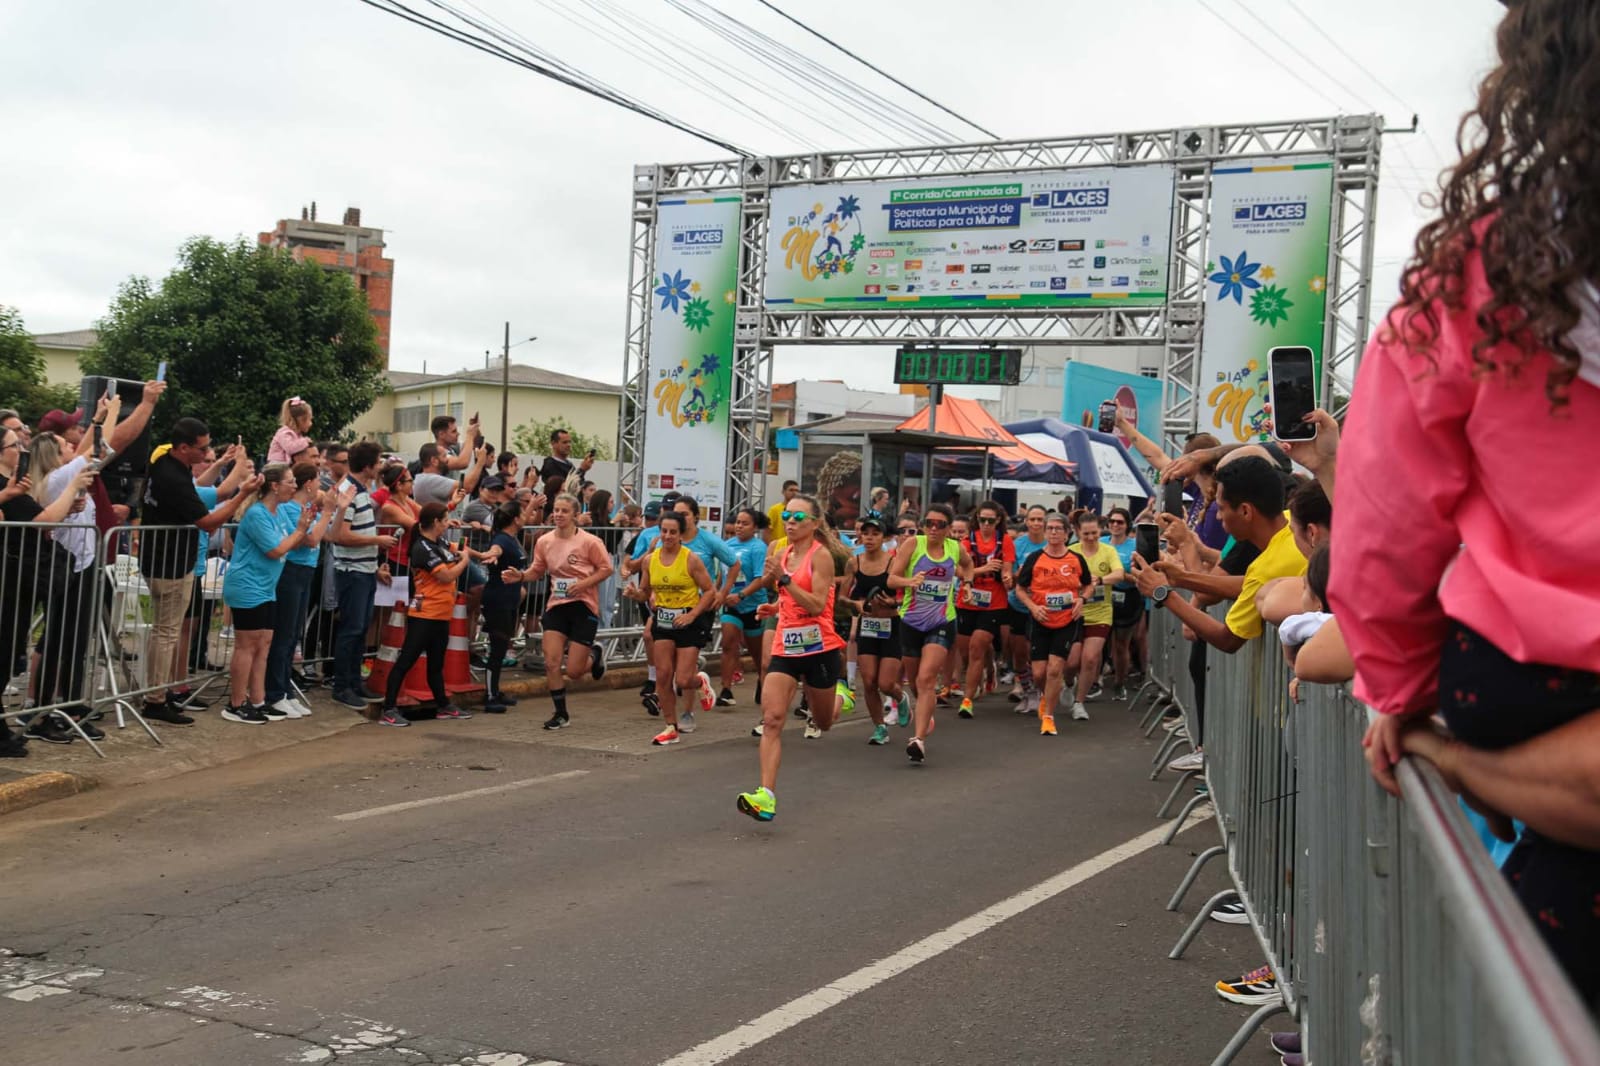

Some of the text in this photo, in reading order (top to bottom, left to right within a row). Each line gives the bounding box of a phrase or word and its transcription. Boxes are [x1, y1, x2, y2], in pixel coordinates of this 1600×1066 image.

[903, 186, 1001, 200] Corrida/Caminhada
[1004, 185, 1019, 195] da
[1053, 191, 1107, 206] LAGES
[893, 203, 1015, 218] Secretaria Municipal de
[1254, 204, 1305, 219] LAGES
[788, 216, 810, 227] DIA
[894, 214, 1012, 229] Políticas para a Mulher
[686, 231, 721, 243] LAGES
[659, 368, 678, 379] DIA
[1216, 371, 1243, 383] DIA
[784, 632, 804, 645] 421
